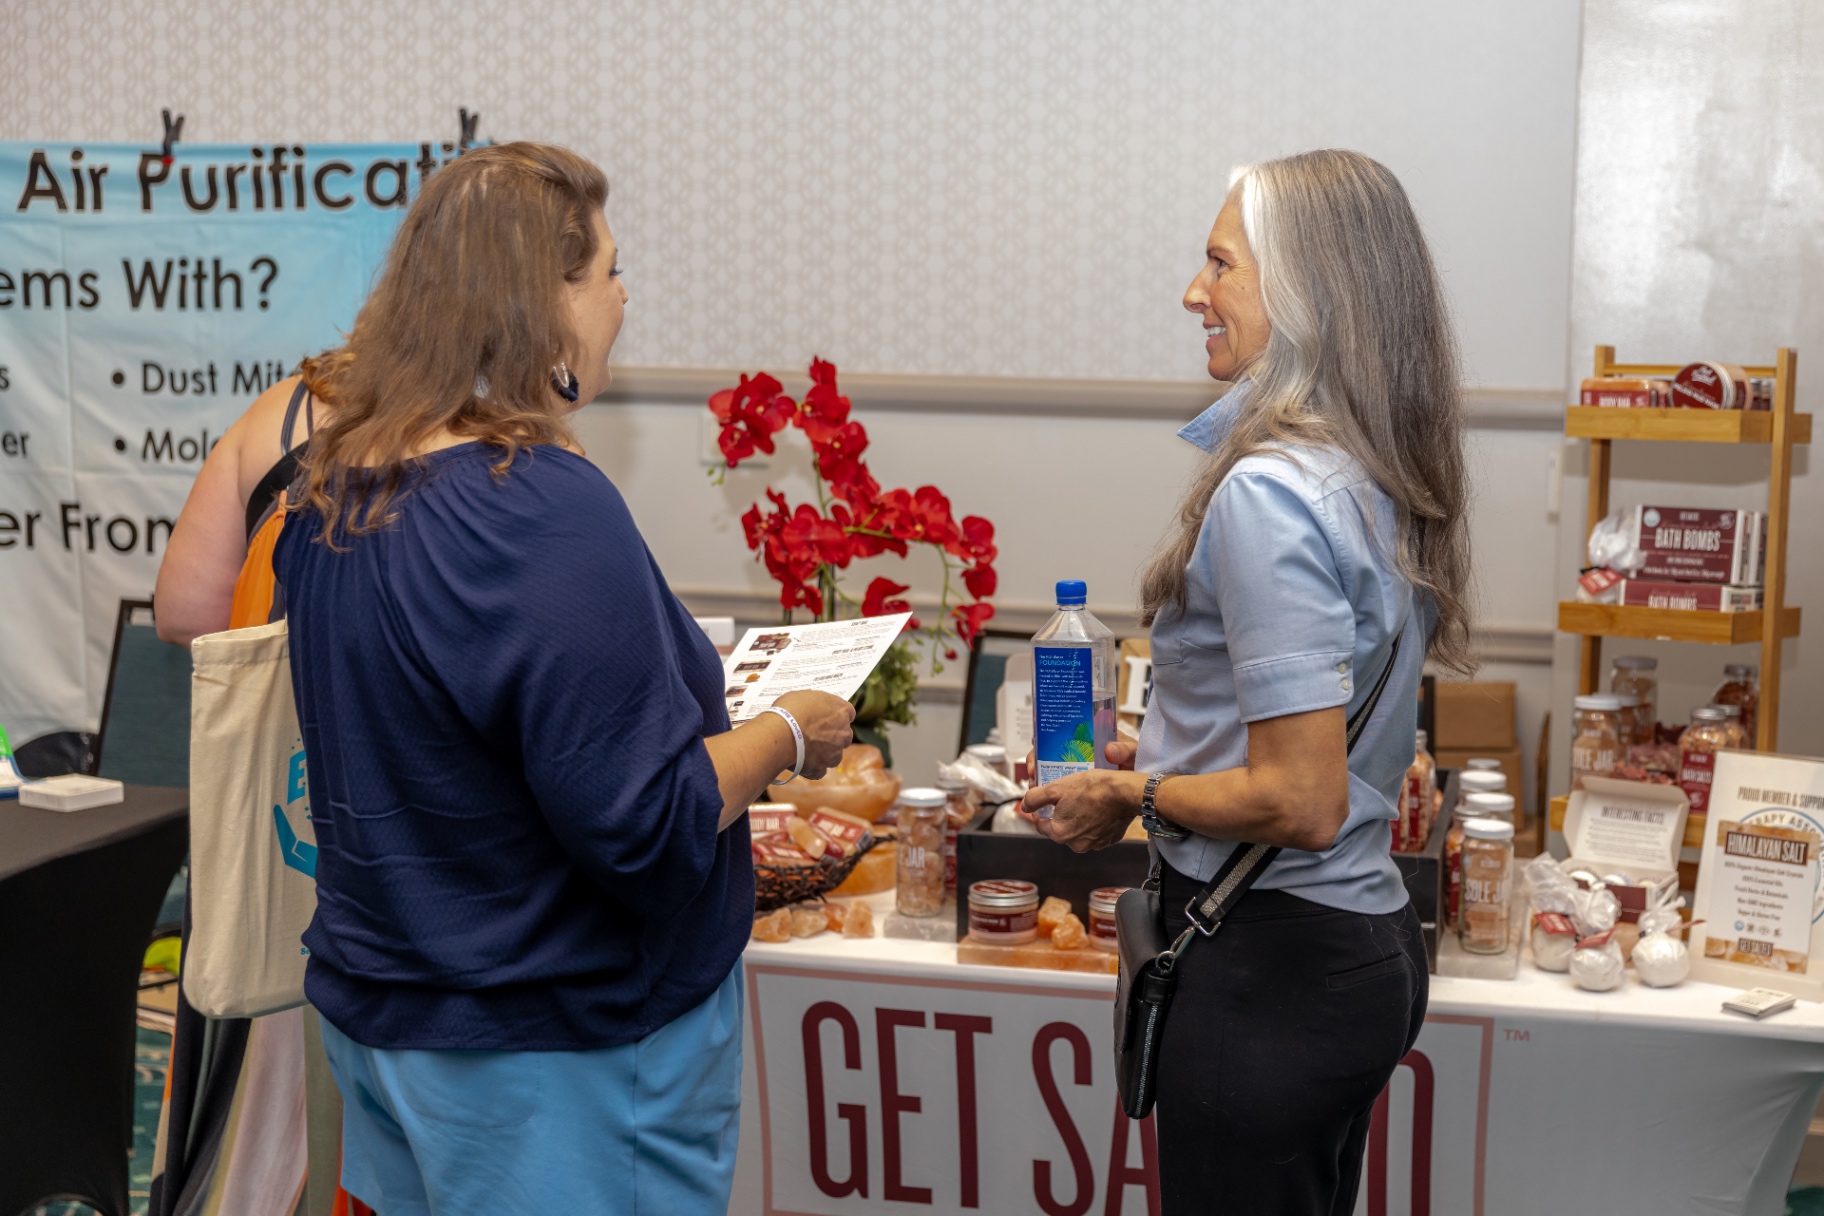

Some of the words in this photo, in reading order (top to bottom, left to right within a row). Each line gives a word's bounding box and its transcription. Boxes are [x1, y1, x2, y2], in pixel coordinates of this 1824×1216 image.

[18, 149, 108, 212] Air
[123, 257, 279, 310] With?
[142, 363, 218, 394] Dust
[233, 361, 297, 394] Mit
[142, 430, 221, 461] Mol
[0, 511, 41, 547] er
[1655, 527, 1682, 549] BATH
[1682, 529, 1721, 552] BOMBS
[1761, 788, 1791, 806] MEMBER
[1601, 806, 1642, 822] INTERESTING
[1727, 831, 1781, 861] HIMALAYAN
[1781, 840, 1807, 865] SALT
[801, 1000, 993, 1209] GET
